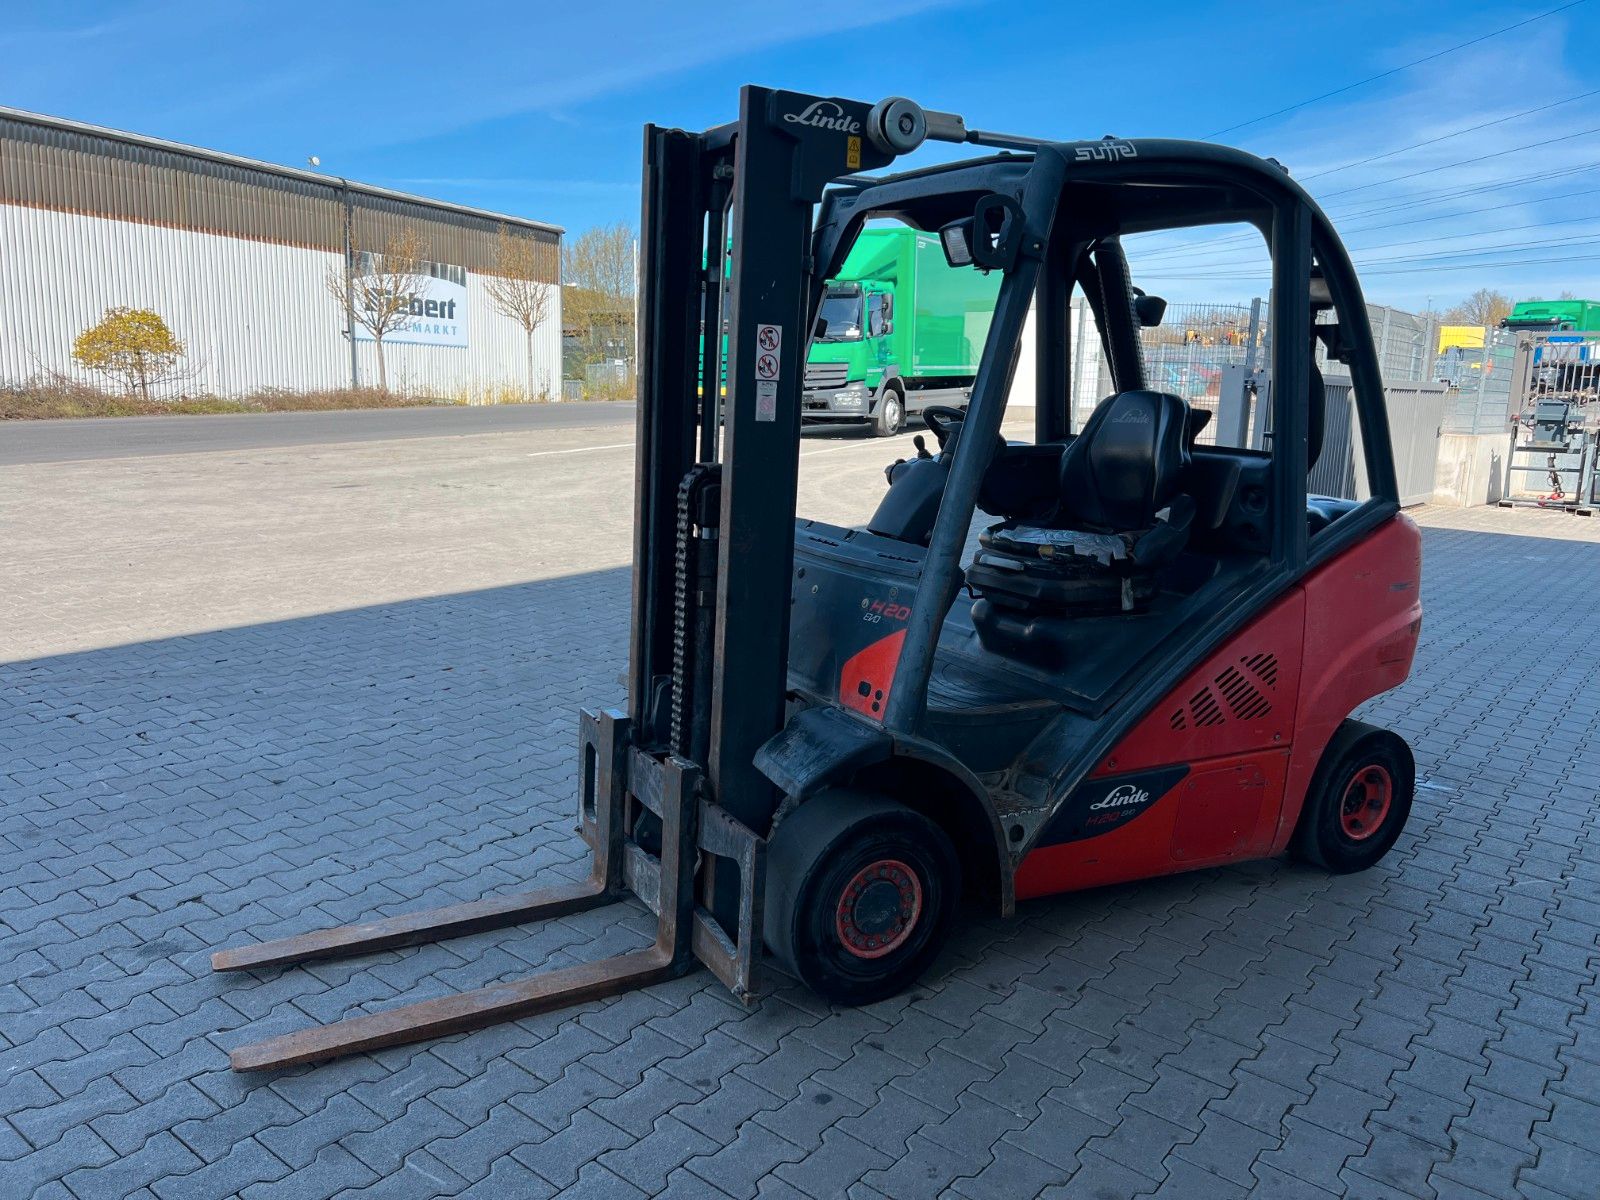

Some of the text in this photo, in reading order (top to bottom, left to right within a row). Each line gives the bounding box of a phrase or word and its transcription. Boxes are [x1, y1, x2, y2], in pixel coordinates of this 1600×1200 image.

[783, 101, 861, 134] Linde
[869, 600, 912, 621] H20
[1089, 784, 1149, 810] Linde
